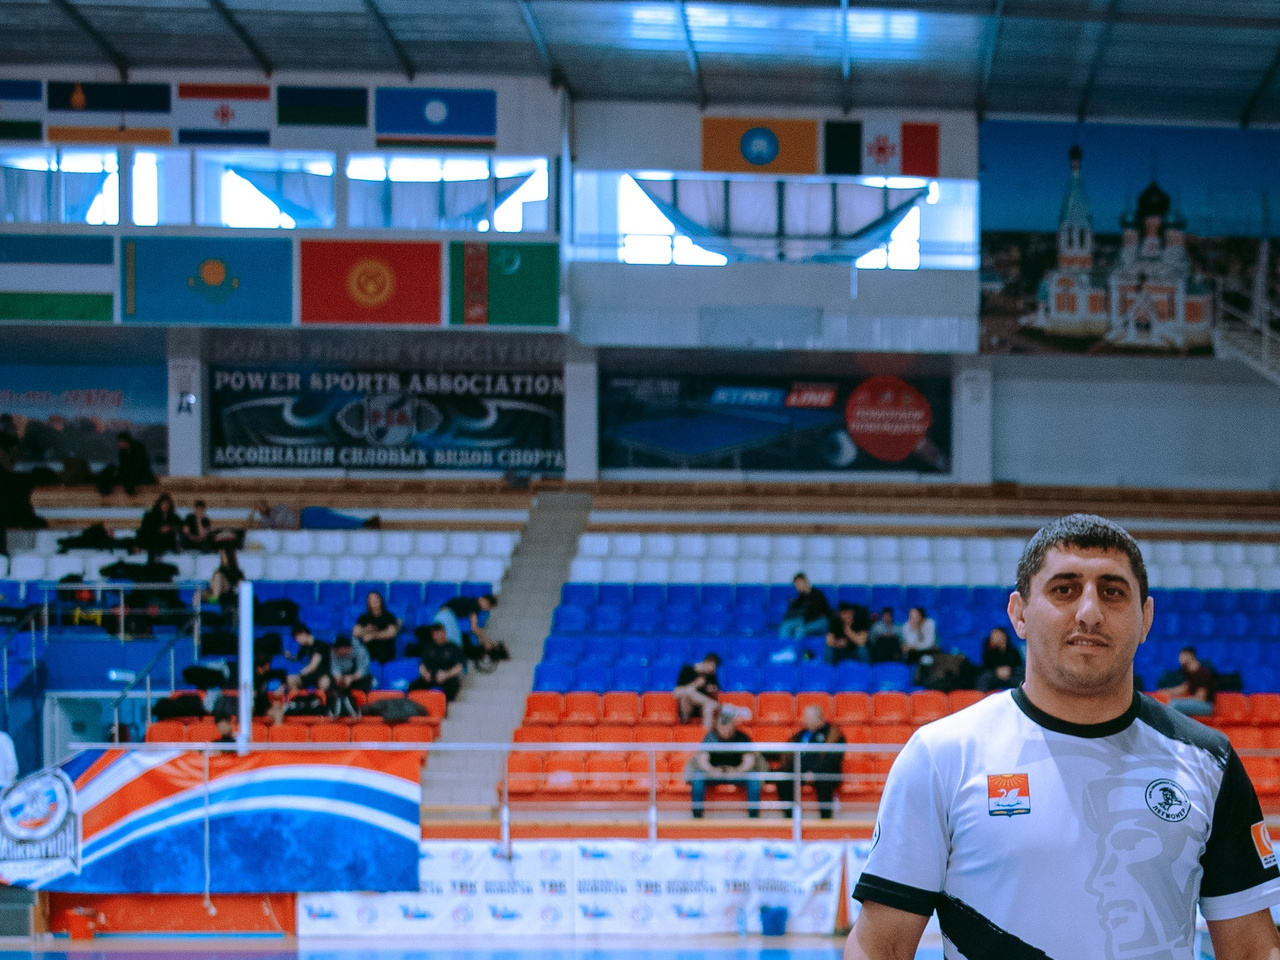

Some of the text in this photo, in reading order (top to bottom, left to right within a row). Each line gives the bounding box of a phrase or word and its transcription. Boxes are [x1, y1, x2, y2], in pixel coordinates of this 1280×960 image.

[215, 371, 301, 391] POWER
[309, 372, 400, 393] SPORTS
[215, 445, 335, 466] АССОЦИАЦИЯ
[339, 446, 428, 466] СИЛОВЫХ
[433, 447, 493, 467] ВИДОВ
[1152, 805, 1186, 819] ЛЕГИОНЕР
